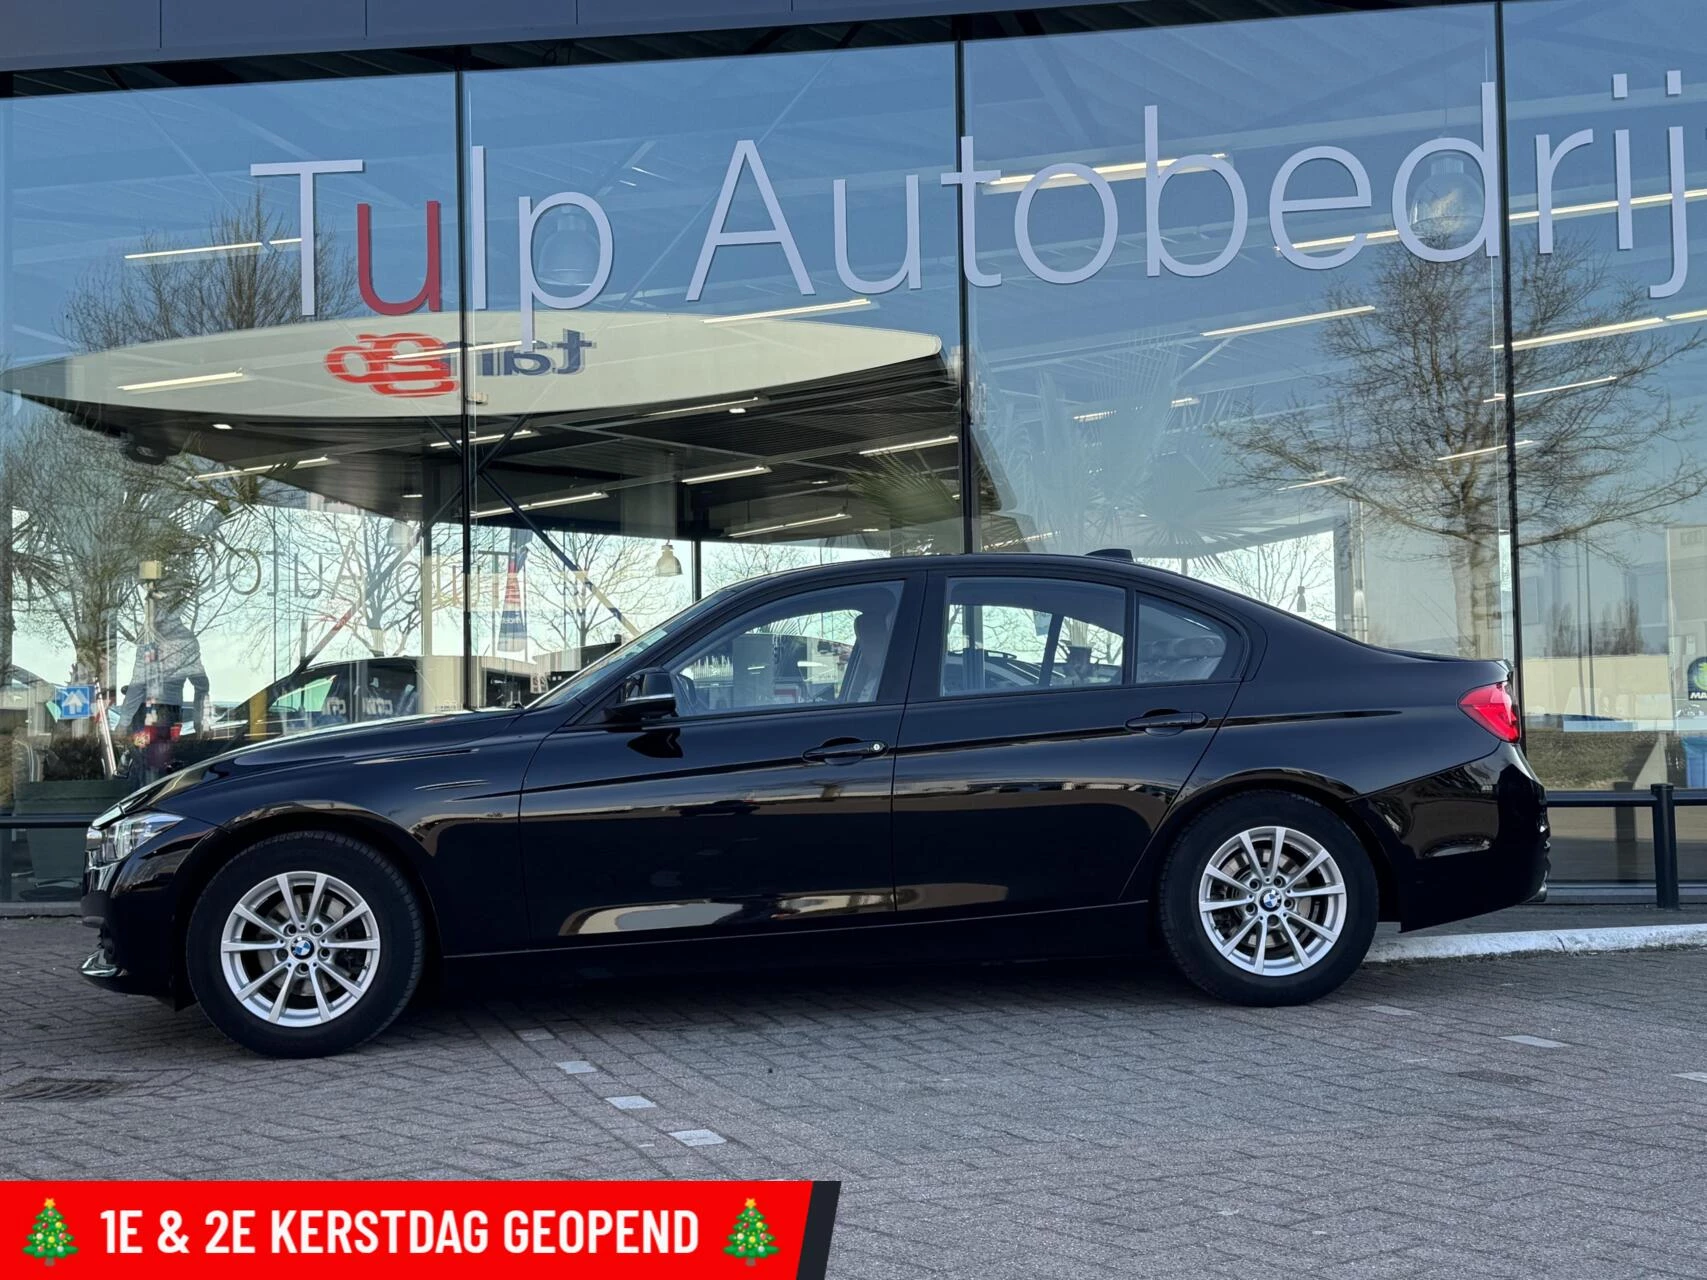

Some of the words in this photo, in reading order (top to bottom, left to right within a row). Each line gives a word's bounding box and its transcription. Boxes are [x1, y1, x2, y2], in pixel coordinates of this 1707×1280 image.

[250, 144, 614, 352] Tulp
[686, 70, 1707, 302] Autobedrij
[1689, 691, 1707, 700] MA
